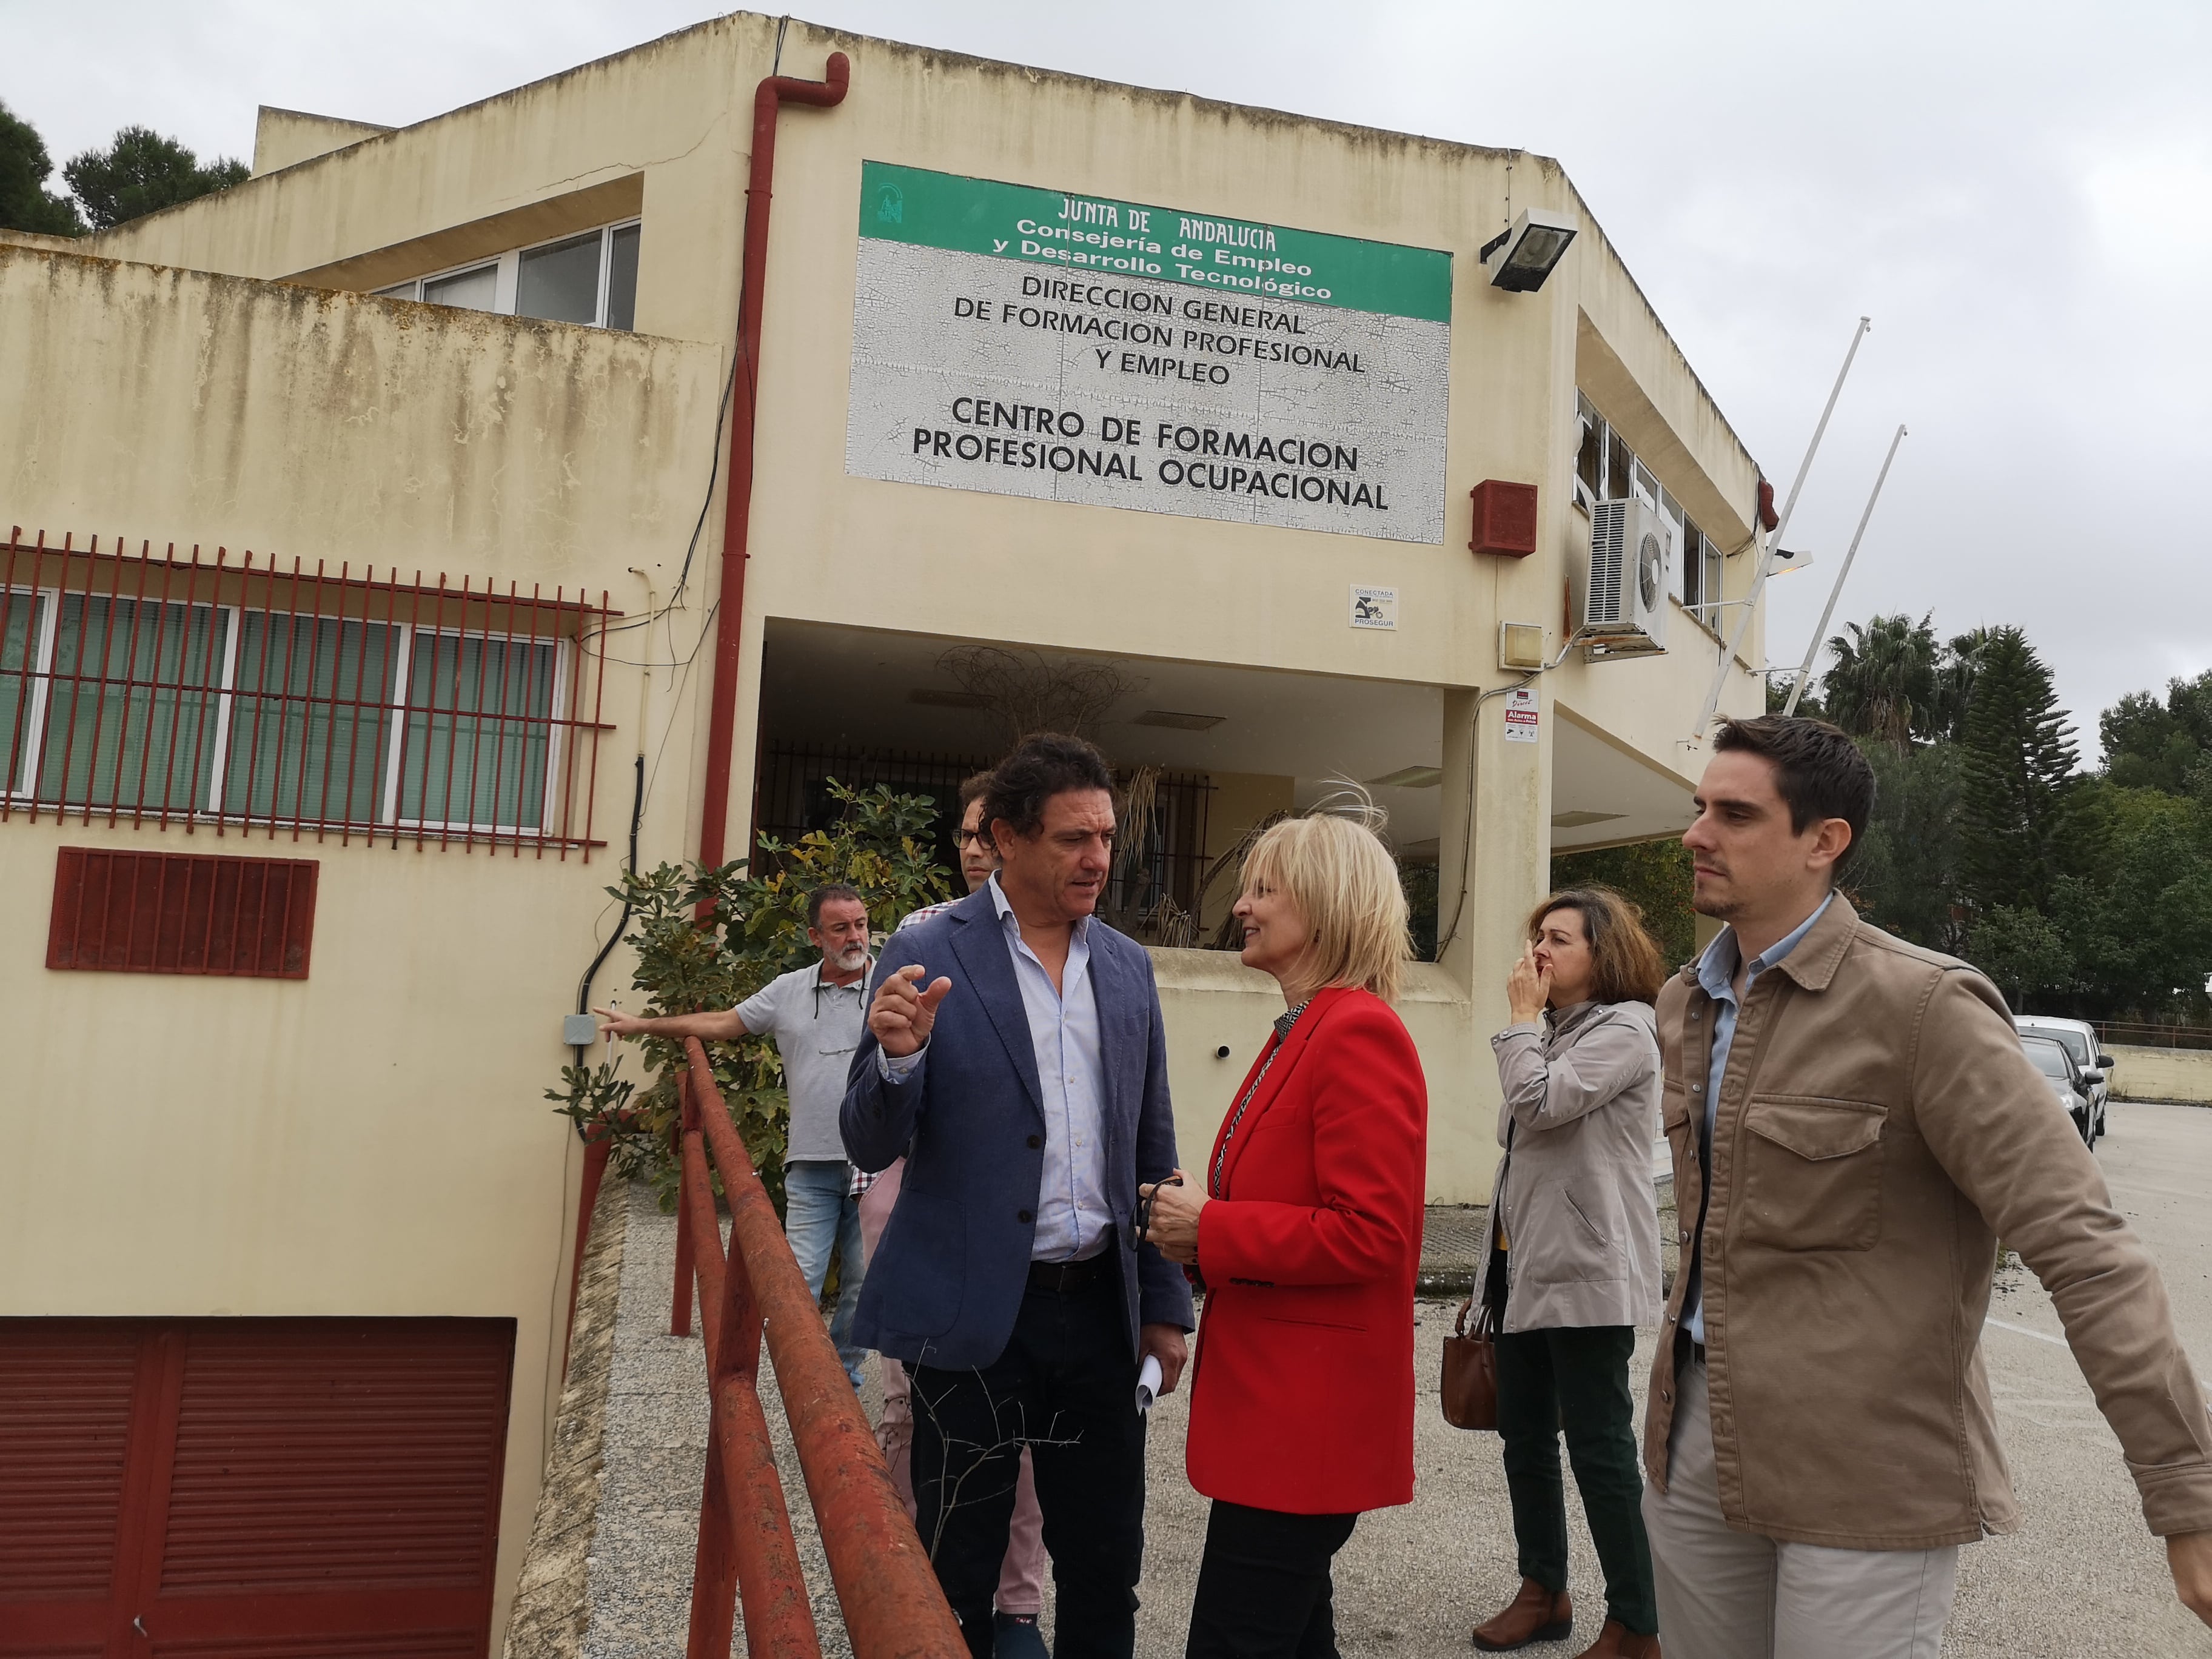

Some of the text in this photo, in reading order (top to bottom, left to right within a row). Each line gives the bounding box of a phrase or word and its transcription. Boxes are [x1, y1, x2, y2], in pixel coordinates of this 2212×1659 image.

[1017, 219, 1312, 276] Consejería de Empleo
[1057, 198, 1276, 252] JUNTA DE ANDALUCIA
[993, 238, 1332, 300] y Desarrollo Tecnológico
[1022, 275, 1306, 335] DIRECCION GENERAL
[954, 297, 1366, 374] DE FORMACION PROFESIONAL
[1094, 348, 1230, 385] Y EMPLEO
[952, 396, 1358, 472] CENTRO DE FORMACION
[913, 427, 1389, 510] PROFESIONAL OCUPACIONAL
[1355, 618, 1393, 626] PROSEGUR
[1508, 711, 1537, 720] Alarma
